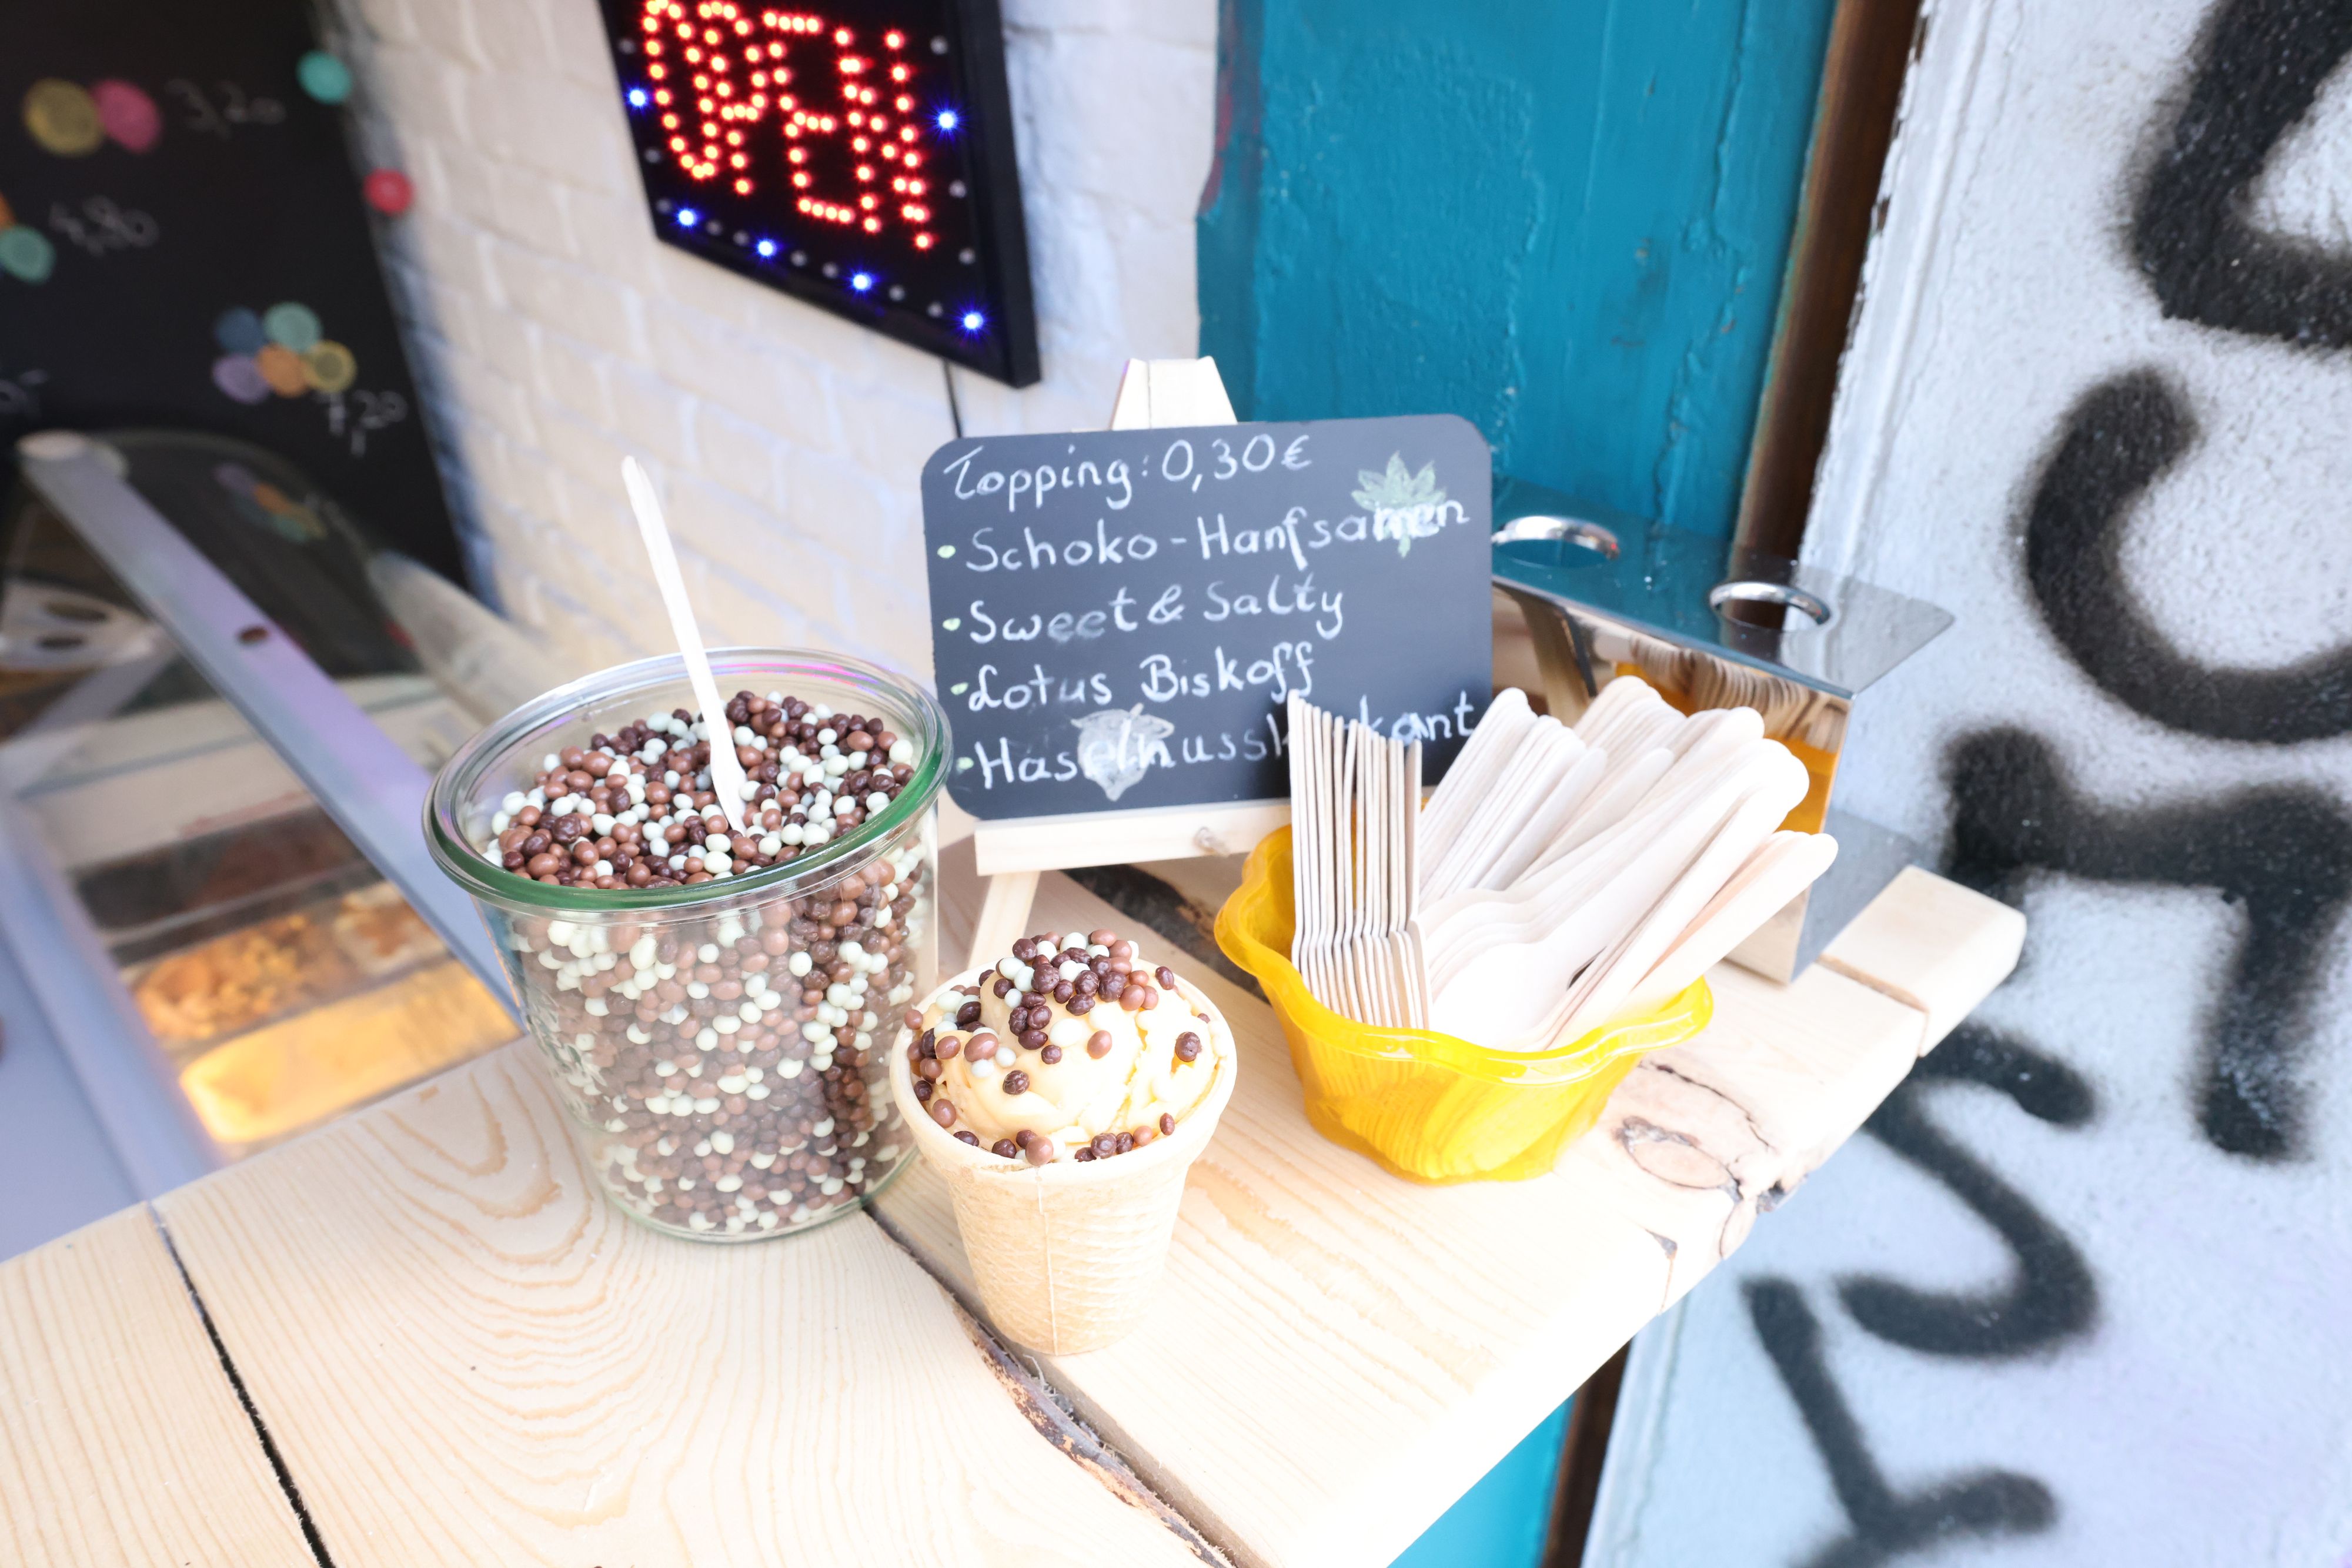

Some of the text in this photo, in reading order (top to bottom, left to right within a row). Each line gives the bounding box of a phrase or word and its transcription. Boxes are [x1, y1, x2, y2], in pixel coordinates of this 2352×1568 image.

[641, 0, 936, 250] OPEN
[969, 572, 1344, 644] Sweet & Salty
[968, 641, 1315, 711] Lotus Biskoff
